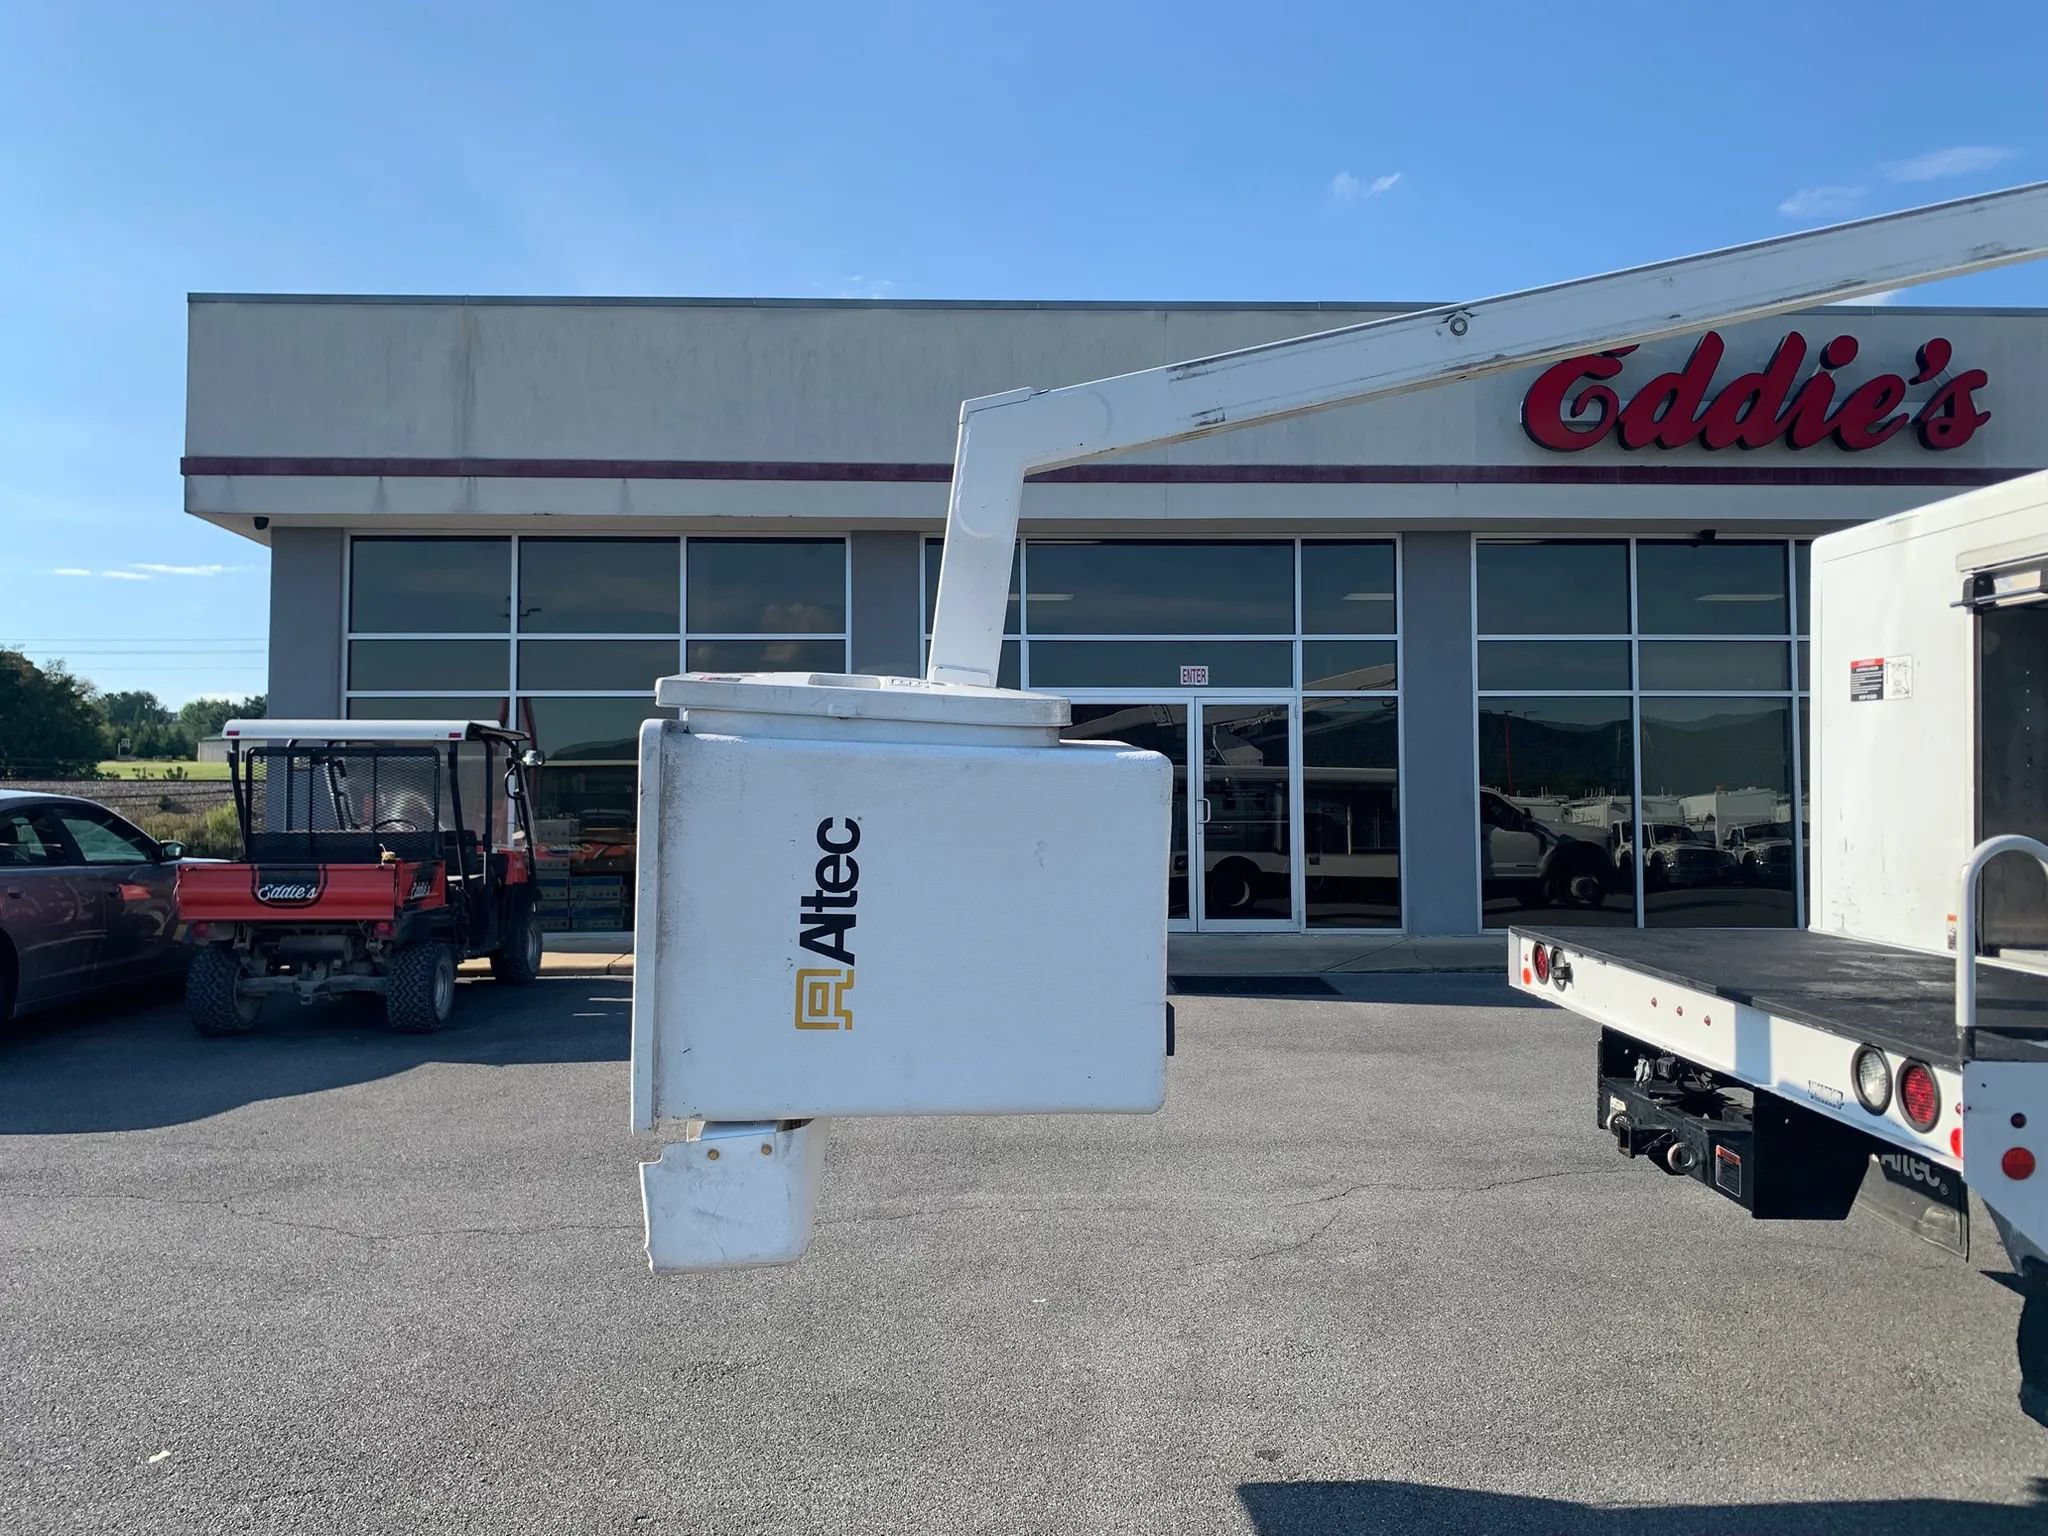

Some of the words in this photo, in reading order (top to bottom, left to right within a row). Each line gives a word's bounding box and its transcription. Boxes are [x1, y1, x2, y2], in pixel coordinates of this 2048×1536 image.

[1521, 331, 1991, 451] Eddie's
[1183, 668, 1206, 683] ENTER
[258, 883, 318, 901] Eddie's
[799, 816, 861, 967] Altec
